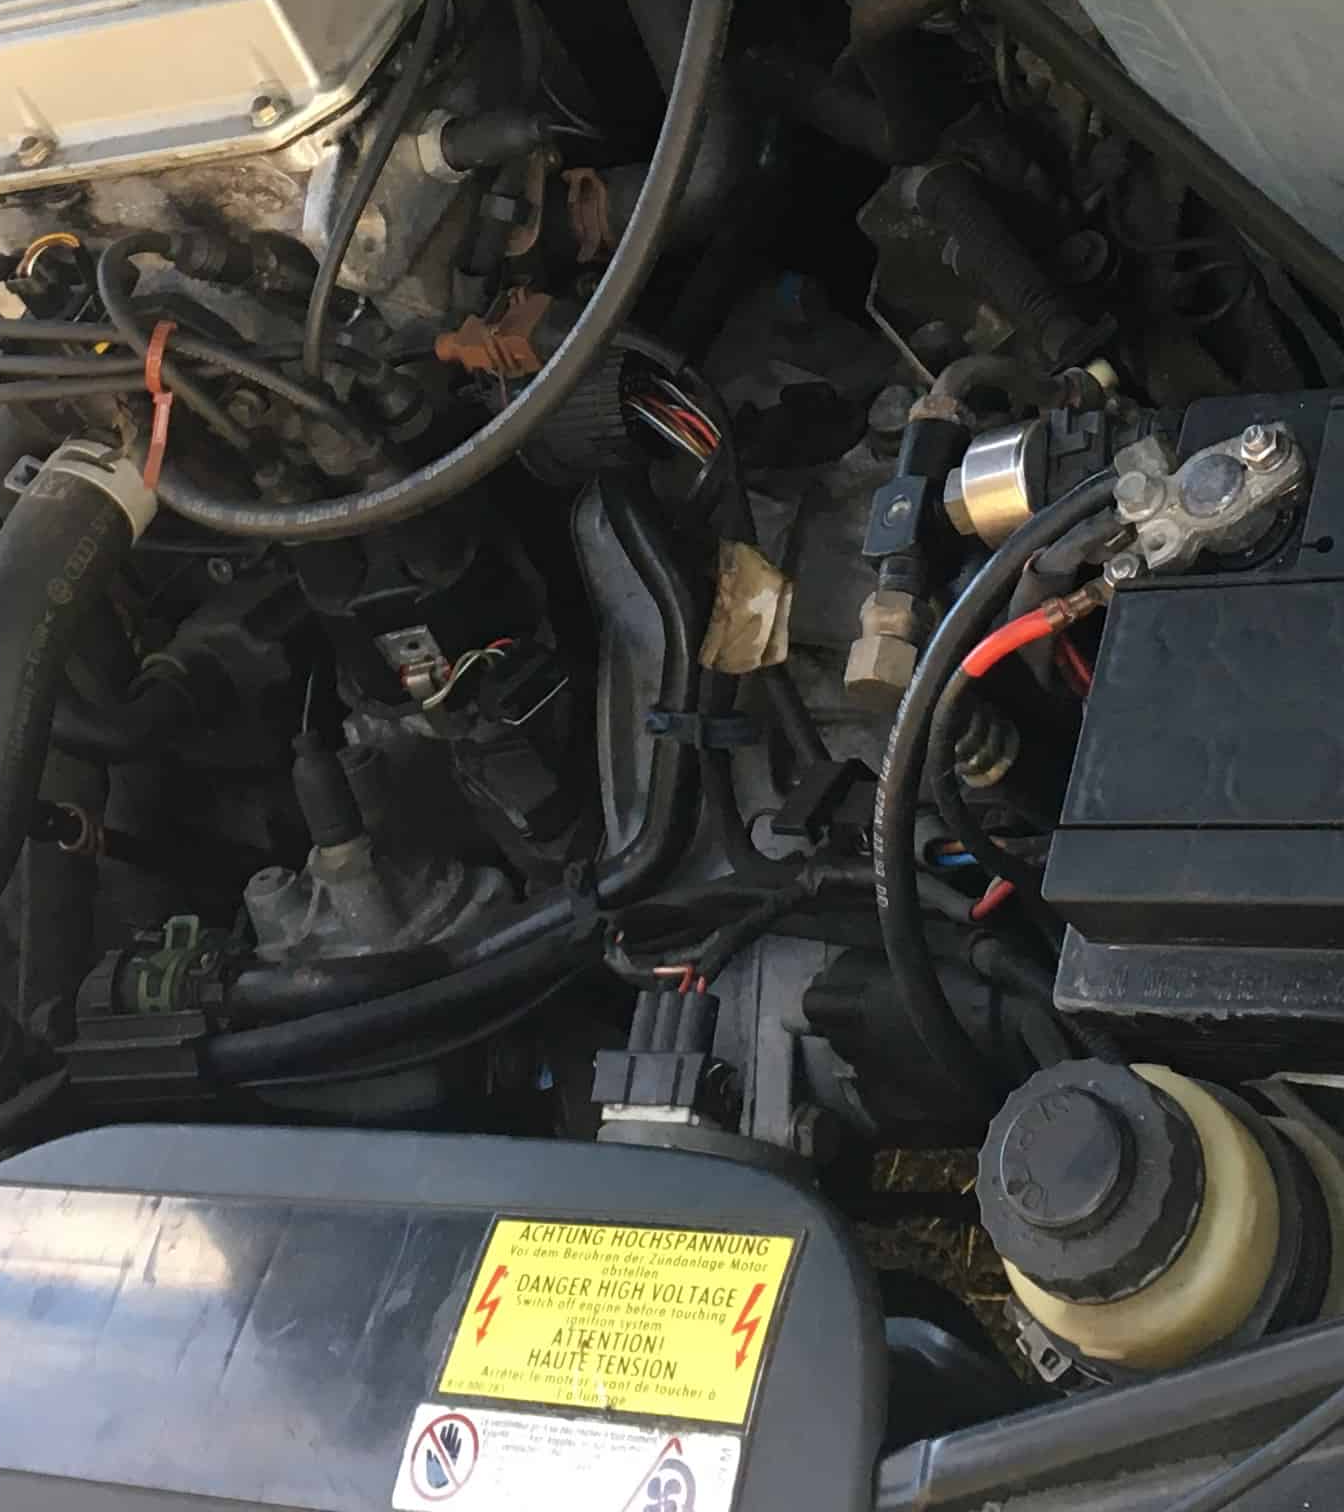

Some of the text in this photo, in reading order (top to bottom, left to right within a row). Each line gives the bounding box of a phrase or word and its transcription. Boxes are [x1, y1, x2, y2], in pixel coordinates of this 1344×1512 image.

[519, 1224, 771, 1257] ACHTUNG HOCHSPANNUNG
[510, 1245, 530, 1257] Vor
[533, 1246, 559, 1258] dem
[623, 1252, 644, 1264] der
[730, 1258, 769, 1273] Motor
[601, 1265, 659, 1279] abstellen
[516, 1274, 738, 1308] DANGER HIGH VOLTAGE
[516, 1294, 727, 1325] Switch off engine before touching
[566, 1315, 663, 1332] ignition system
[551, 1328, 665, 1355] ATTENTION!
[527, 1348, 678, 1380] HAUTE TENSION
[529, 1369, 541, 1381] le
[635, 1380, 649, 1393] de
[655, 1383, 703, 1399] toucher
